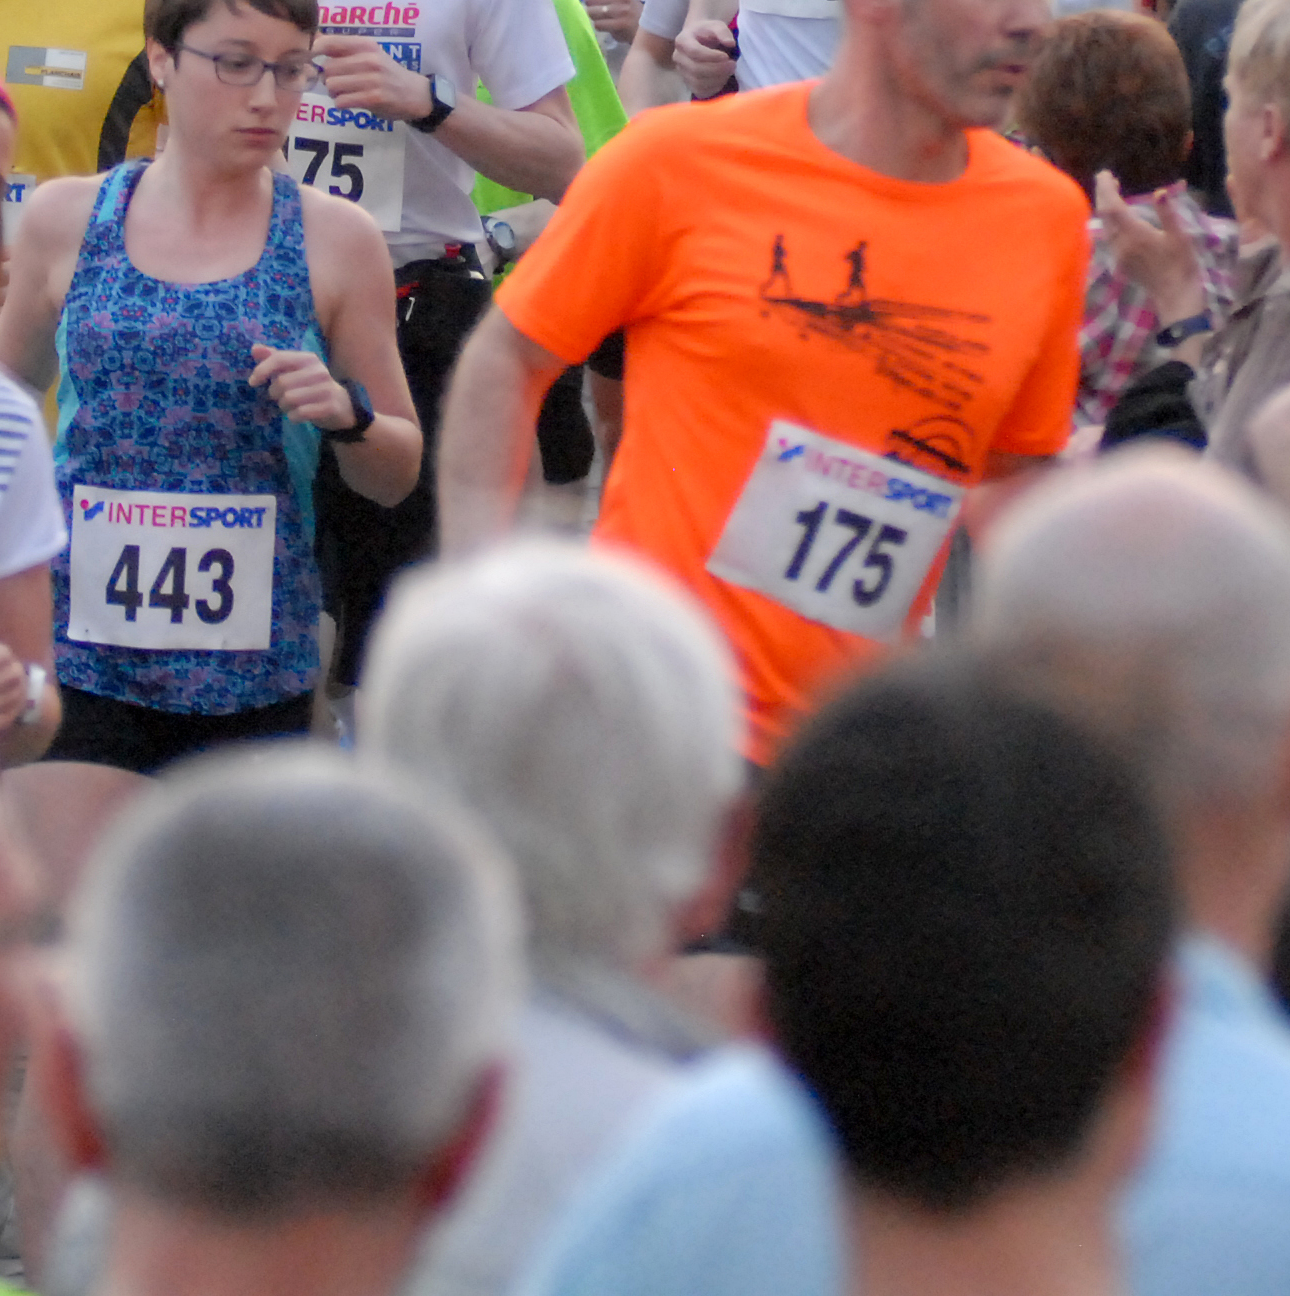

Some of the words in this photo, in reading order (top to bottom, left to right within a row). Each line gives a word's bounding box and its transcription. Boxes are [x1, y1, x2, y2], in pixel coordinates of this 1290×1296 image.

[283, 135, 365, 203] 75
[108, 502, 268, 529] INTERSPORT
[105, 544, 235, 626] 443
[783, 500, 908, 609] 175
